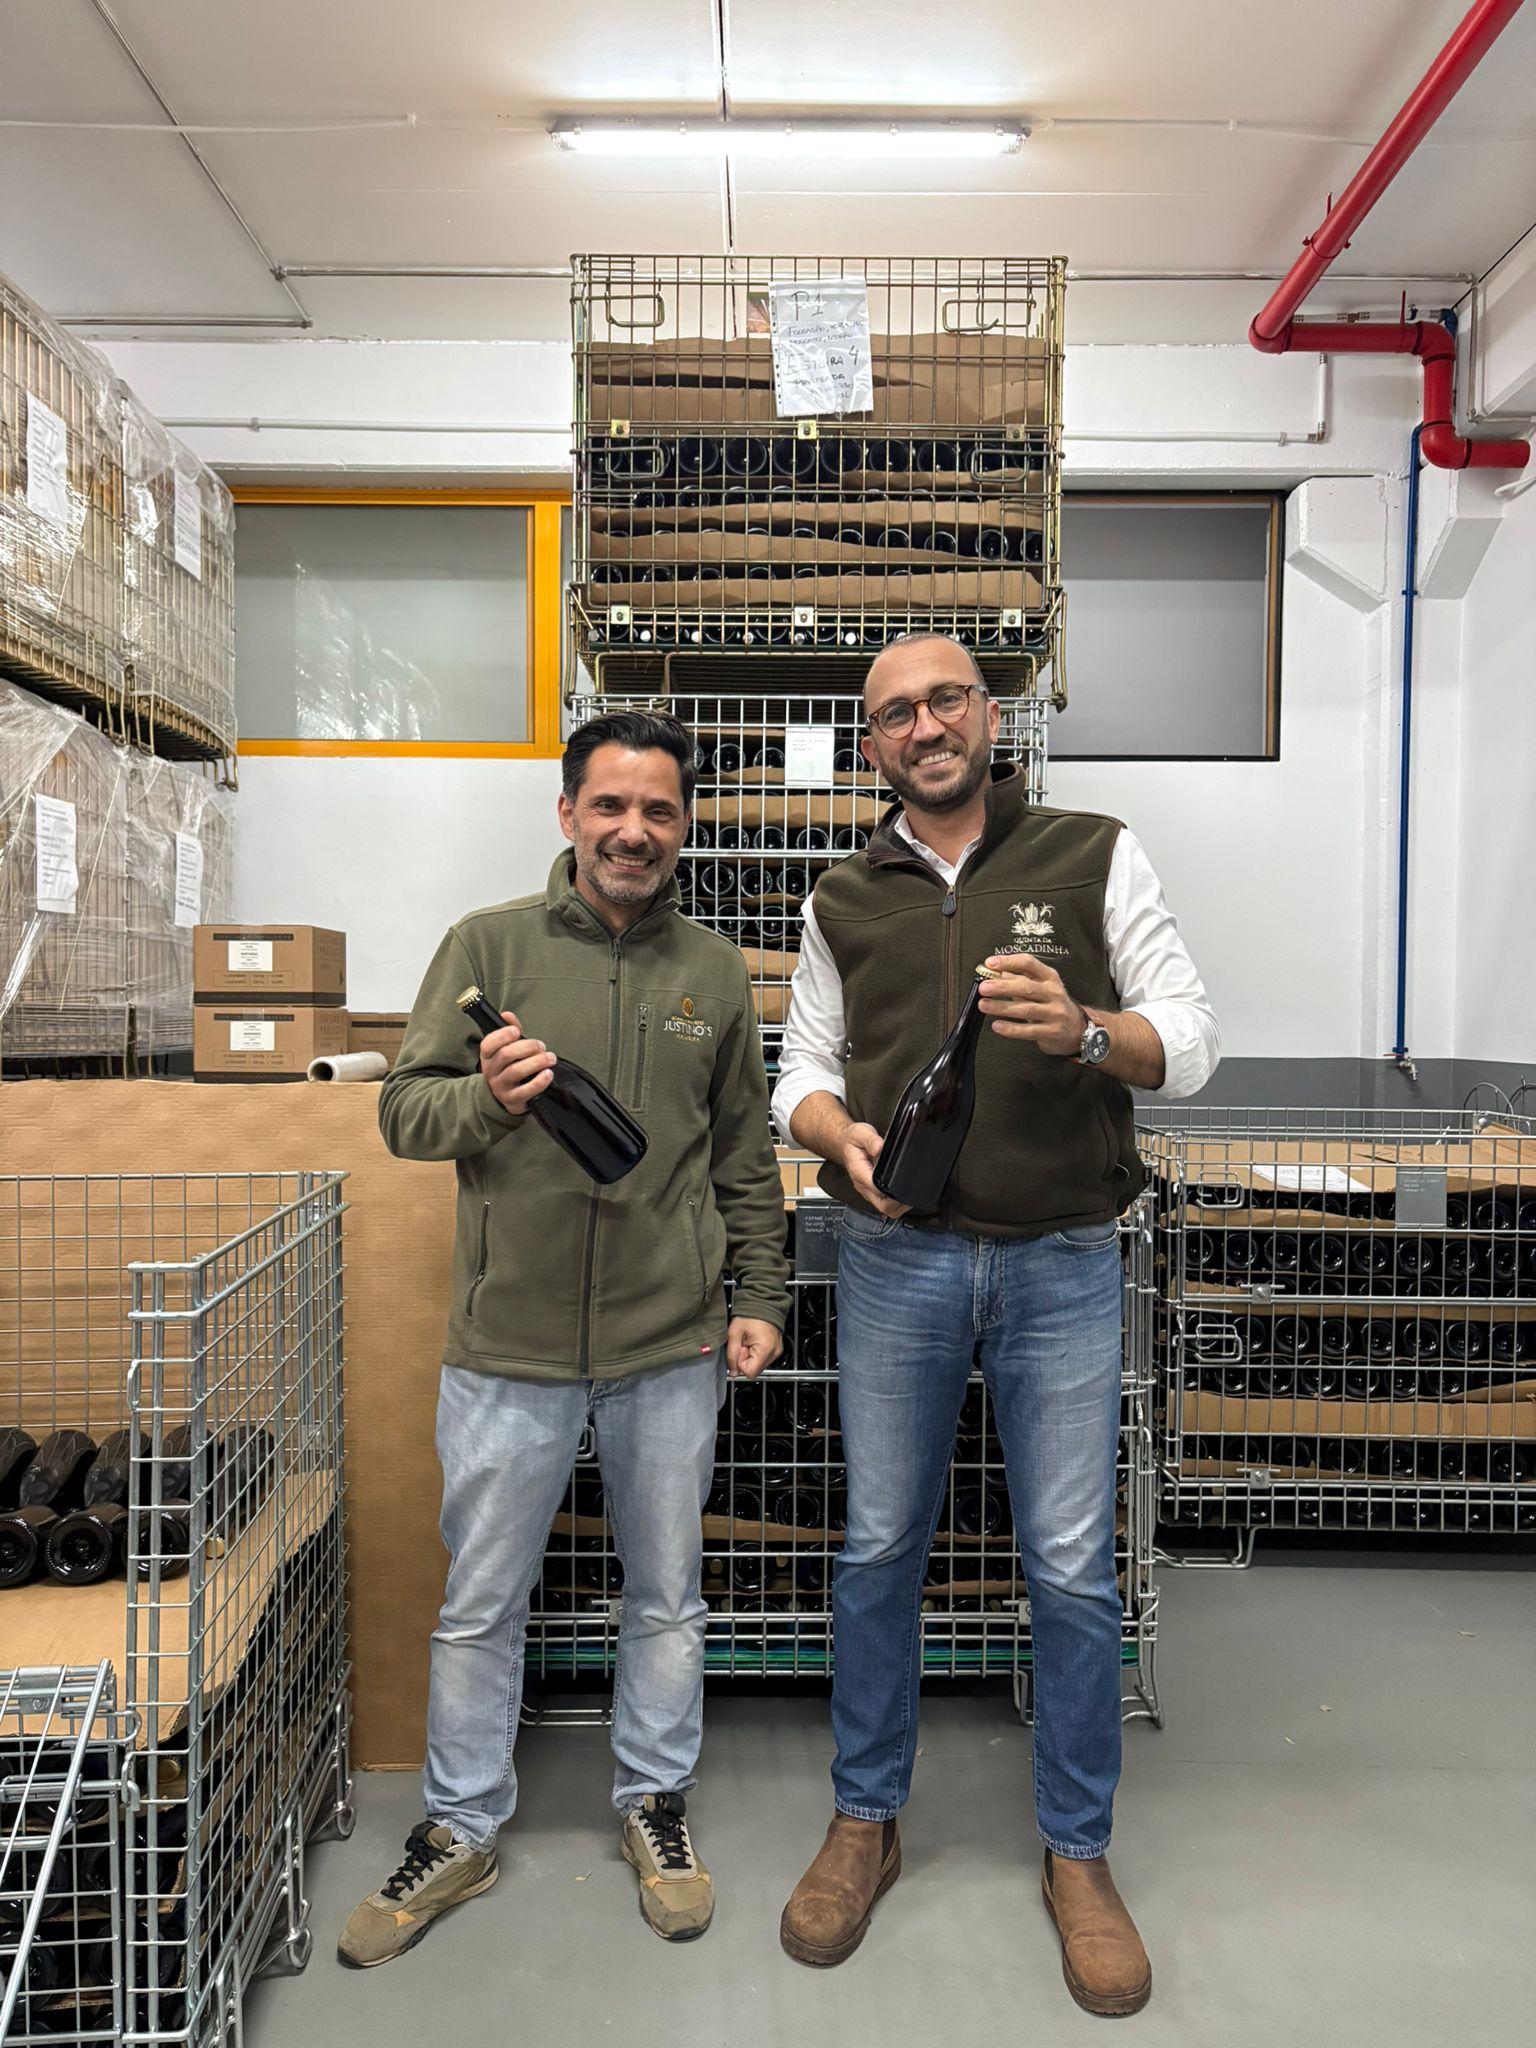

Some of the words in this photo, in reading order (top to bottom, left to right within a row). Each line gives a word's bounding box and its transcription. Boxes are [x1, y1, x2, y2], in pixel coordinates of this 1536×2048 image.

[1013, 936, 1040, 944] QUINTA
[994, 944, 1070, 955] MOSCADINHA
[663, 1020, 713, 1037] JUSTINO'S
